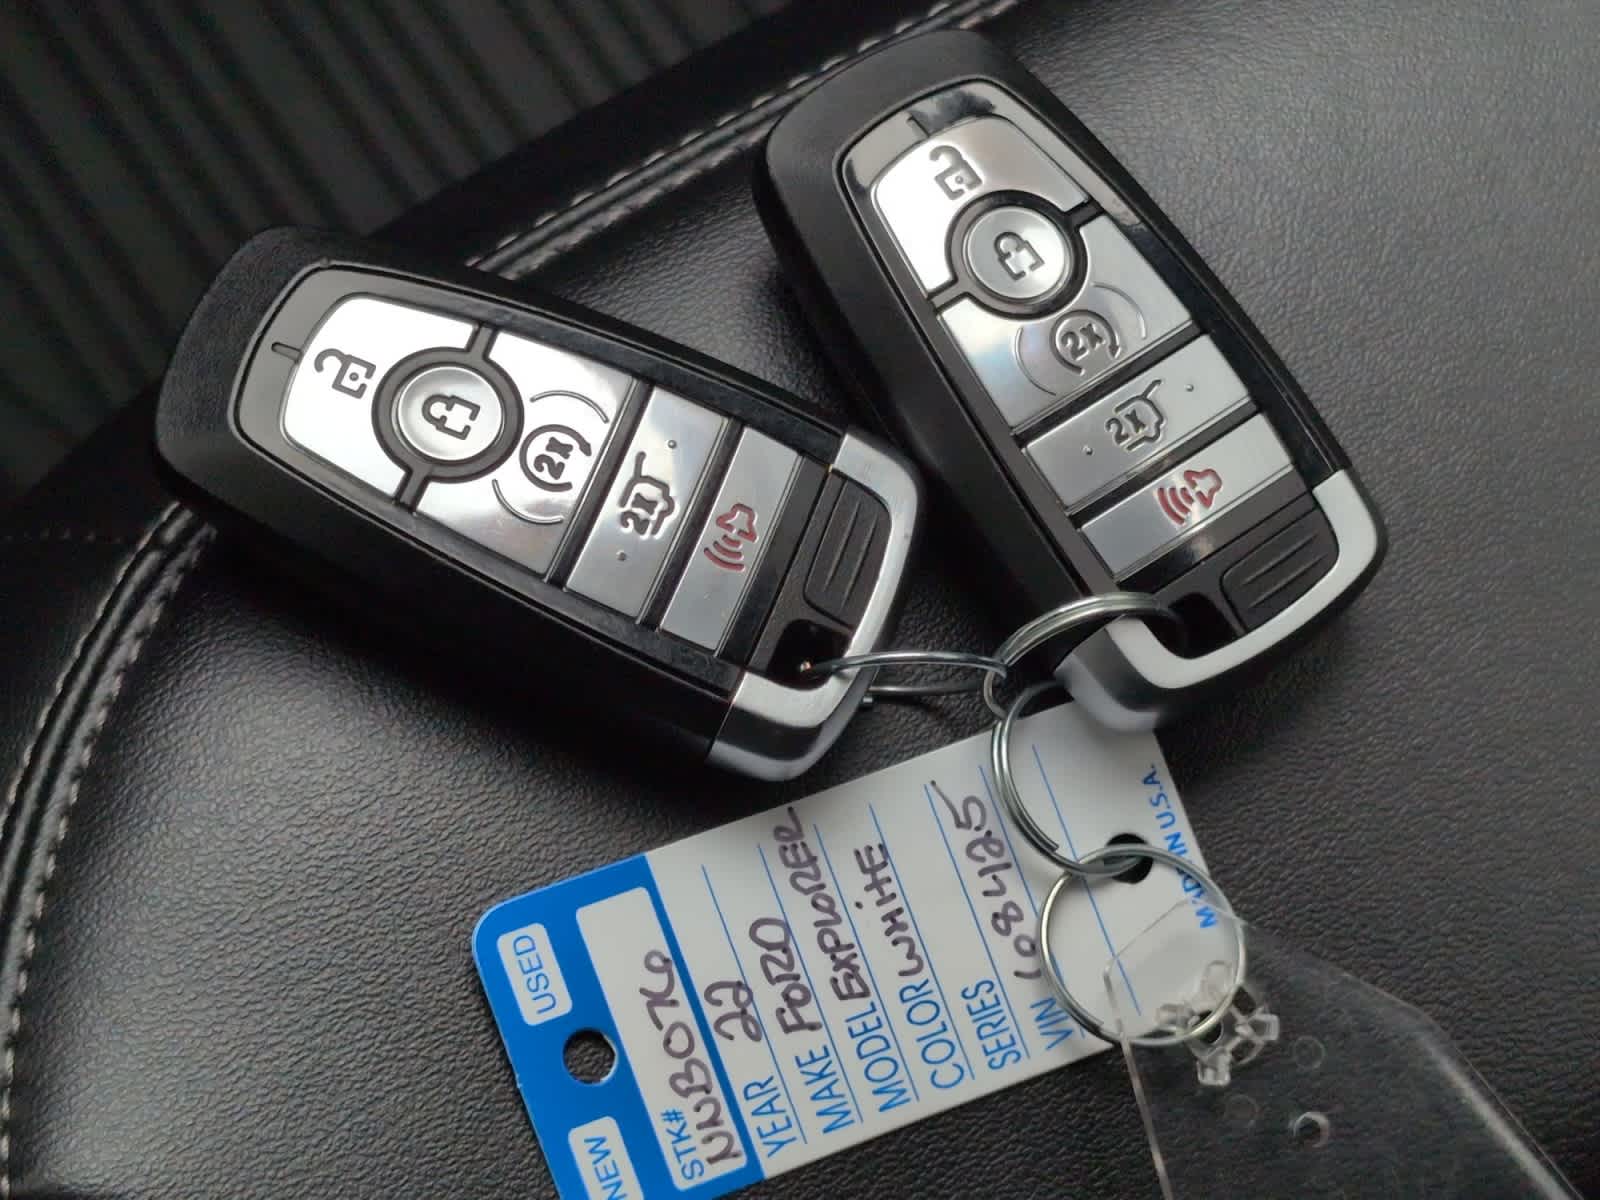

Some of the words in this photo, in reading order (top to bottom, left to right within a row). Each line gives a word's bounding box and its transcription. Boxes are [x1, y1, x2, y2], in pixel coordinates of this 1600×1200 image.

[1142, 764, 1176, 829] U.S.A.
[1165, 831, 1188, 857] IN
[773, 806, 871, 1002] EXPLORER
[512, 934, 557, 1015] USED
[704, 979, 763, 1042] 22
[749, 916, 823, 1035] FORD
[844, 1001, 912, 1113] MODEL
[899, 978, 965, 1090] COLOR
[961, 979, 1022, 1071] SERIES
[1029, 997, 1076, 1051] VIN
[743, 1075, 797, 1158] YEAR
[795, 1044, 855, 1134] MAKE
[583, 1136, 628, 1200] NEW
[660, 1108, 705, 1181] STK#
